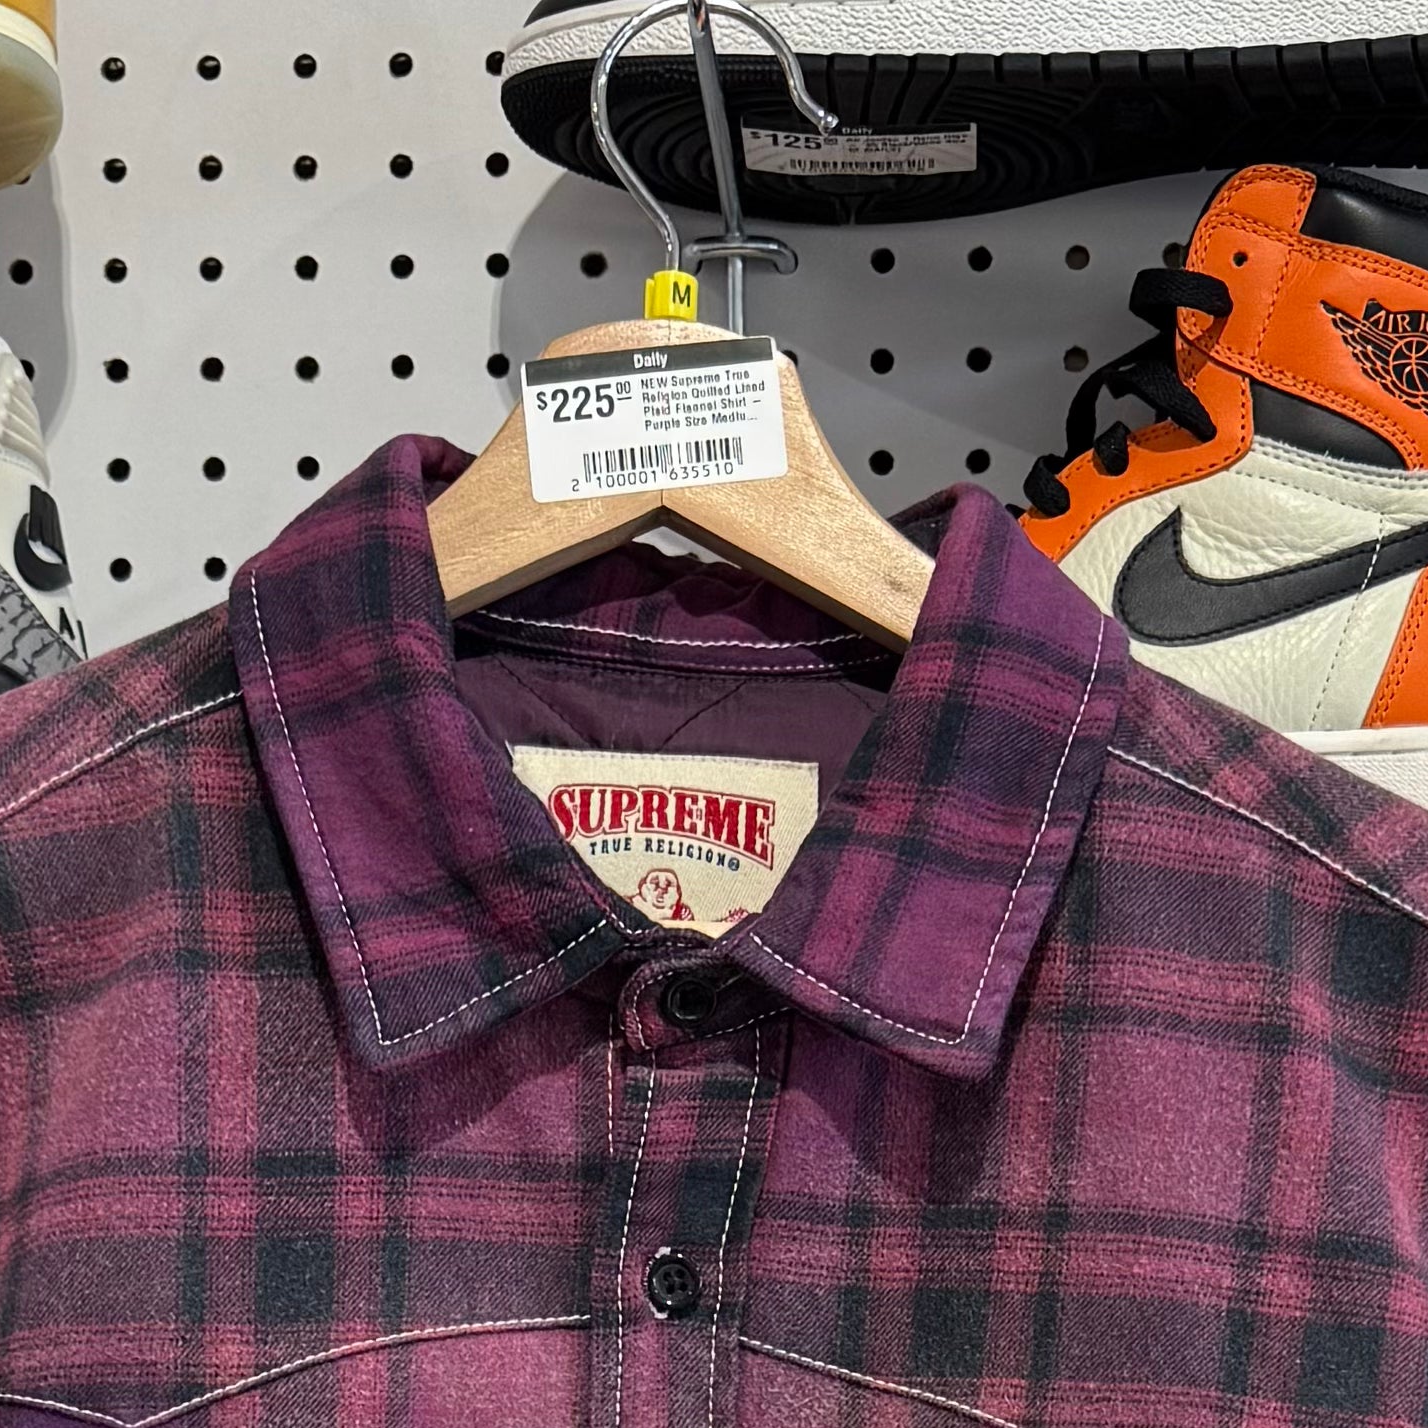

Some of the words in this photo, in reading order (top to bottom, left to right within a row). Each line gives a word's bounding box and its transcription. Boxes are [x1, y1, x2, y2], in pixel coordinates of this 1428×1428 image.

[749, 130, 822, 150] $125
[671, 281, 691, 308] M
[1369, 310, 1411, 334] AIR
[633, 353, 668, 369] Daily
[640, 376, 668, 389] NEW
[671, 373, 721, 387] Supreme
[725, 369, 750, 381] True
[642, 390, 688, 405] Religion
[691, 384, 730, 399] Quilted
[735, 380, 765, 395] Lined
[643, 402, 671, 417] Plaid
[720, 396, 747, 410] Shirt
[644, 417, 681, 432] Purple
[684, 415, 708, 428] Size
[548, 784, 776, 871] SUPREME
[589, 837, 632, 856] TRUE
